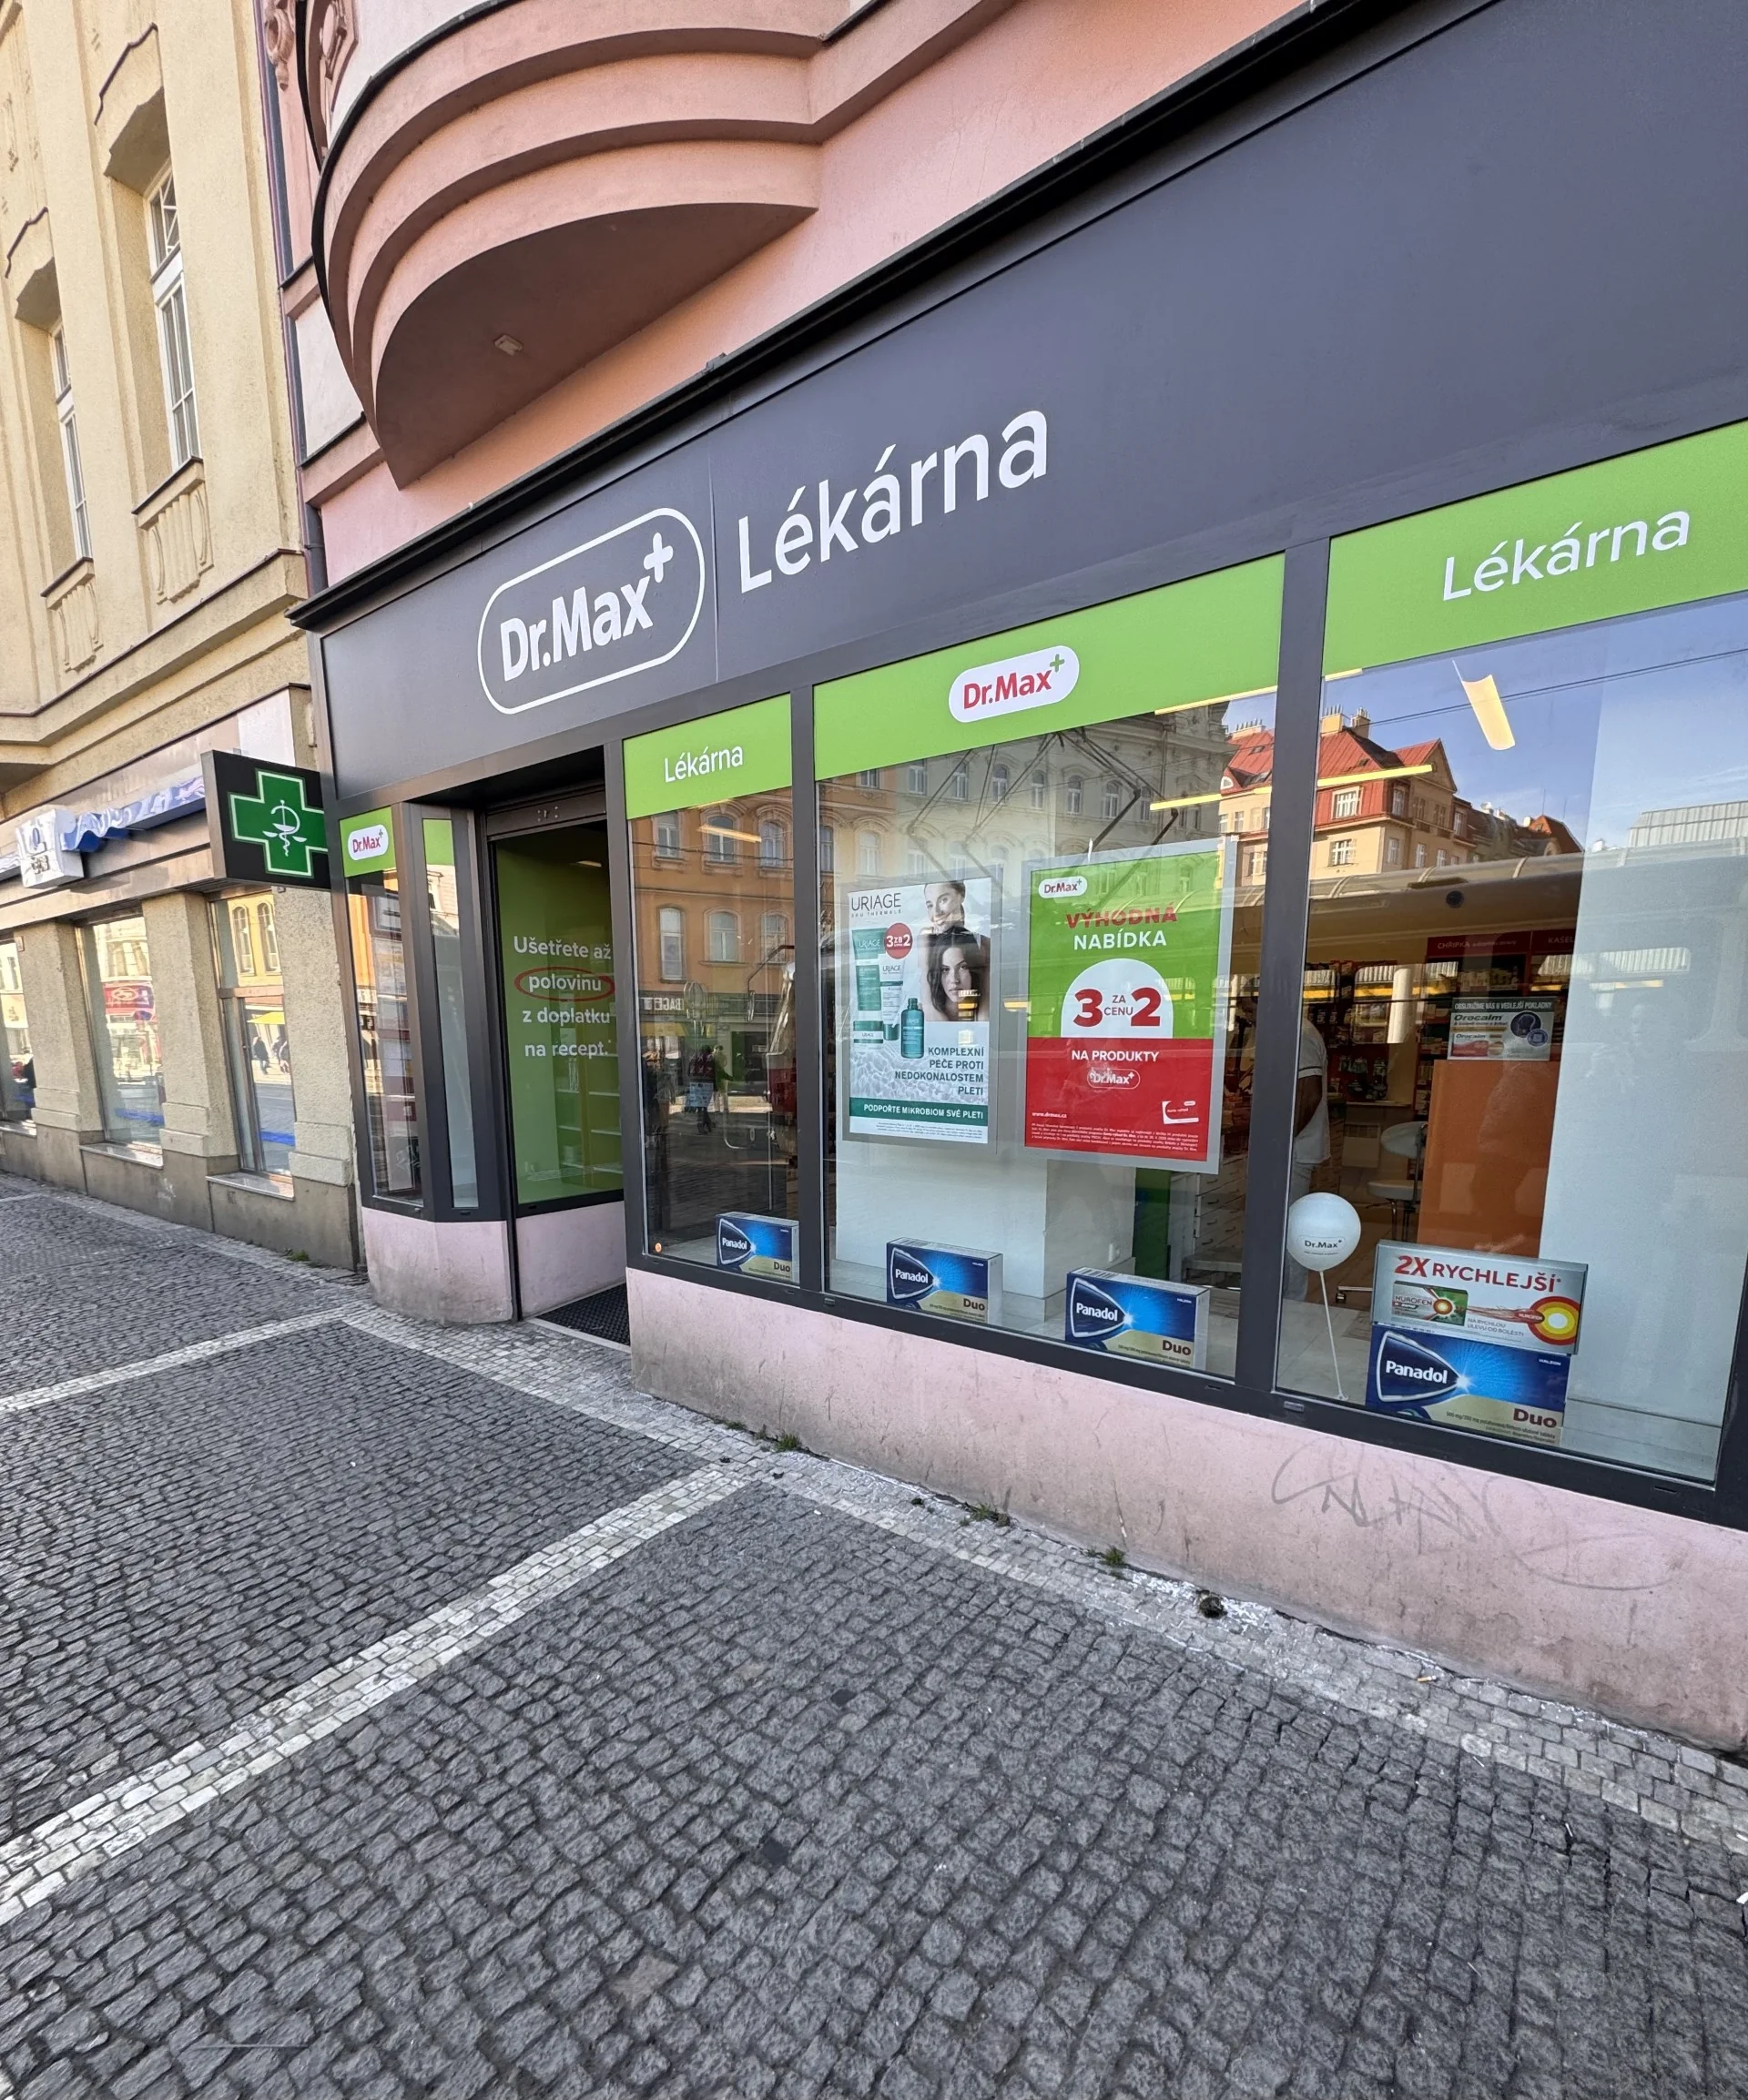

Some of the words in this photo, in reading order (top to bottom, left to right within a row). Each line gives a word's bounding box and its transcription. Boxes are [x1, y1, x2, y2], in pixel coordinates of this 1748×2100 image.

[737, 411, 1048, 593] Lékárna
[1443, 511, 1691, 601] Lékárna
[664, 743, 744, 783] Lékárna
[851, 893, 901, 911] URIAGE
[1066, 902, 1177, 929] VÝHODNÁ
[513, 936, 589, 958] Ušetřete
[594, 944, 611, 959] až
[886, 936, 894, 948] 3
[902, 934, 910, 947] 2
[1073, 928, 1167, 950] NABÍDKA
[529, 974, 602, 992] polovinu
[1072, 989, 1103, 1027] 3
[1113, 995, 1126, 1004] ZA
[1130, 987, 1162, 1026] 2
[523, 1010, 532, 1023] z
[537, 1007, 610, 1027] doplatku
[1103, 1007, 1133, 1016] CENU
[525, 1044, 545, 1057] na
[552, 1041, 608, 1059] recept.
[928, 1047, 984, 1057] KOMPLEXNÍ
[1072, 1050, 1089, 1060] NA
[1092, 1050, 1160, 1062] PRODUKTY
[955, 1060, 984, 1070] PROTI
[895, 1071, 984, 1083] NEDOKONALOSTEM
[958, 1086, 983, 1096] PLETI
[864, 1103, 900, 1113] PODPOŘTE
[902, 1107, 944, 1116] MIKROBIOM
[946, 1108, 960, 1117] SVÉ
[962, 1111, 984, 1119] PLETI
[722, 1236, 747, 1251] Panadol
[774, 1262, 790, 1273] Duo
[895, 1268, 929, 1283] Panadol
[1394, 1255, 1431, 1279] 2X
[963, 1298, 985, 1312] Duo
[1395, 1295, 1432, 1306] NUROFEN
[1076, 1302, 1118, 1321] Panadol
[1162, 1340, 1192, 1355] Duo
[1386, 1360, 1448, 1385] Panadol
[1513, 1408, 1557, 1428] Duo
